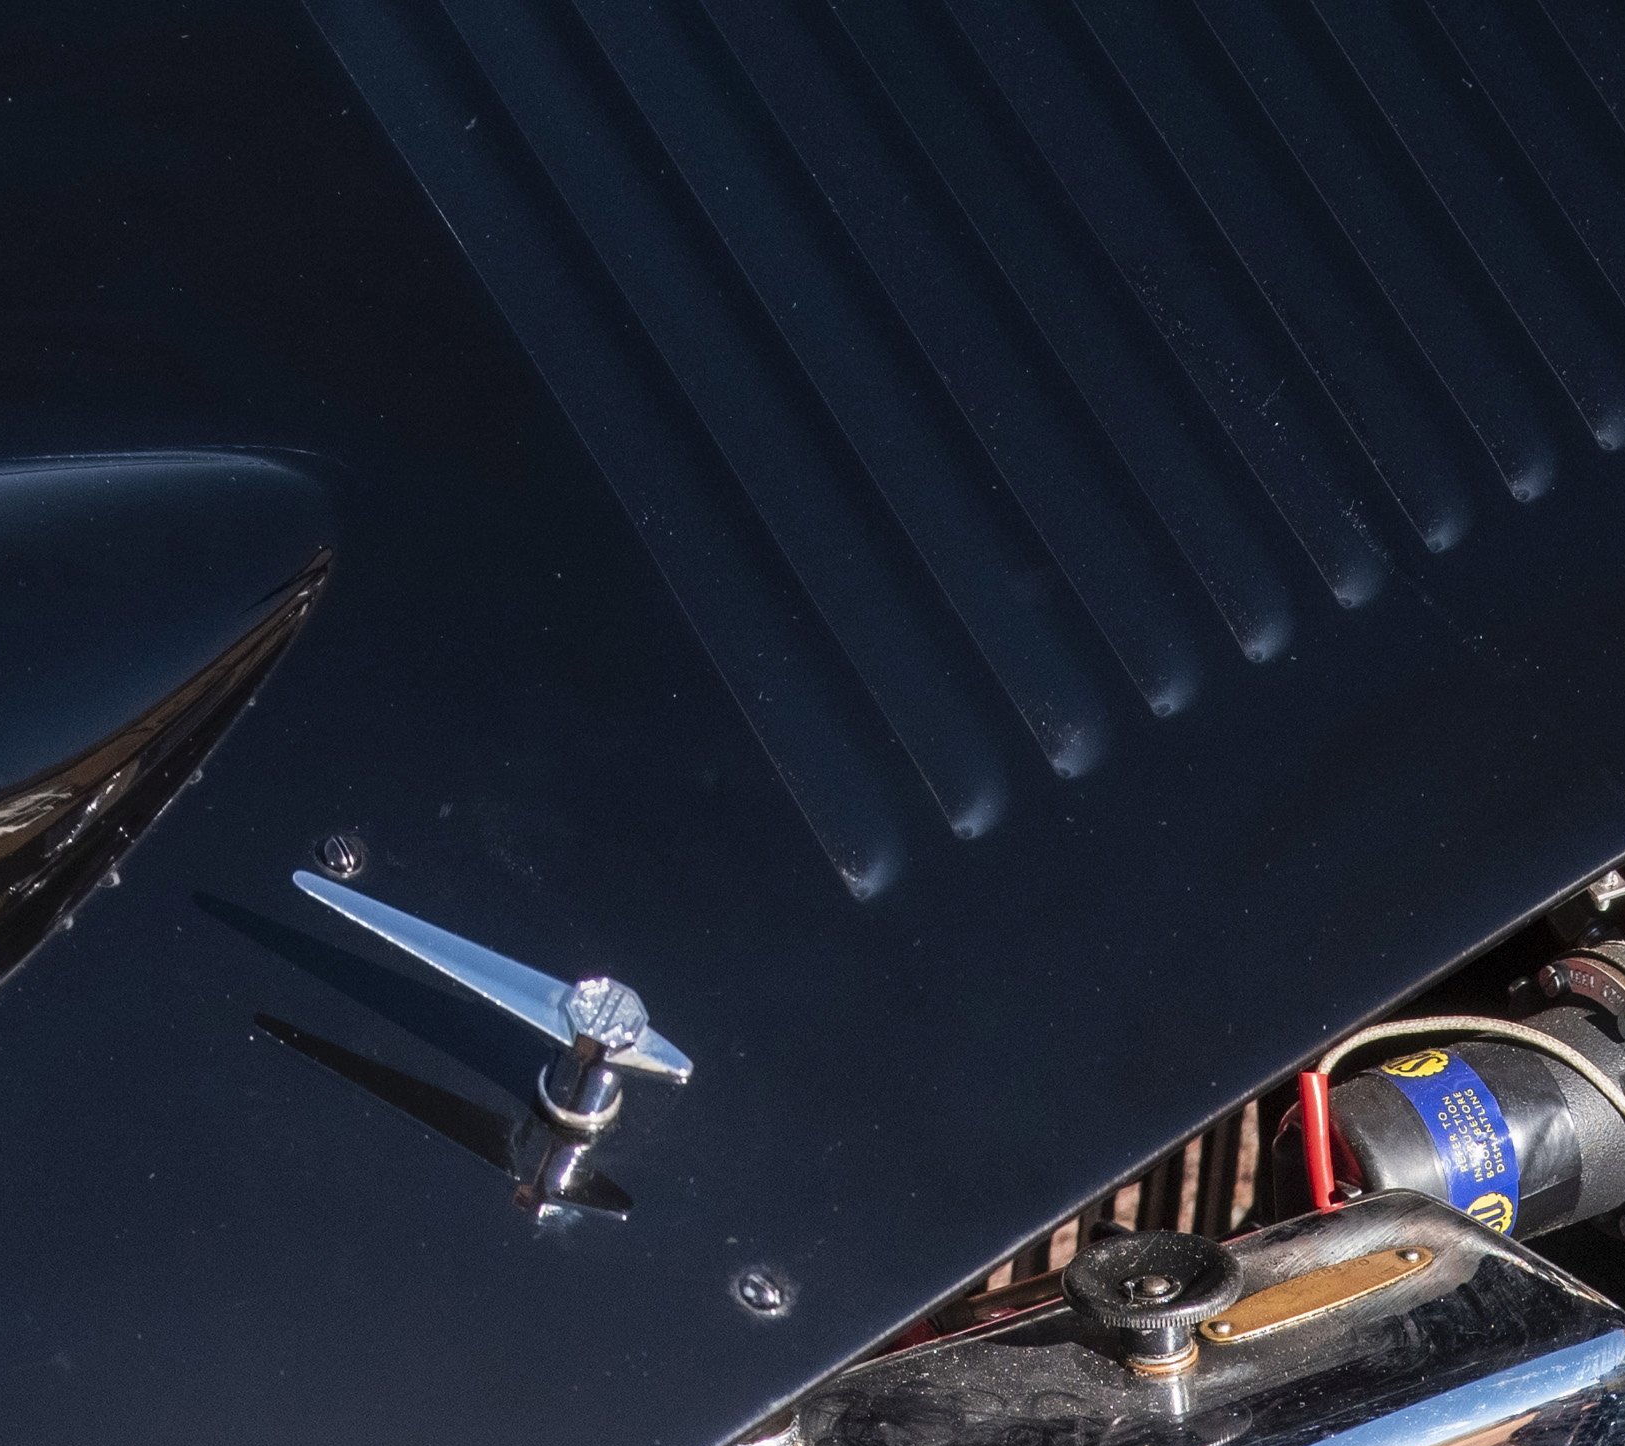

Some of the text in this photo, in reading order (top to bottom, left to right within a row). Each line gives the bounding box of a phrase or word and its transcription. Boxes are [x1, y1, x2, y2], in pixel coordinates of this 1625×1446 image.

[1438, 1112, 1469, 1173] REFER TO
[1453, 1092, 1482, 1136] BEFORE
[1464, 1088, 1506, 1173] DISMANTLING
